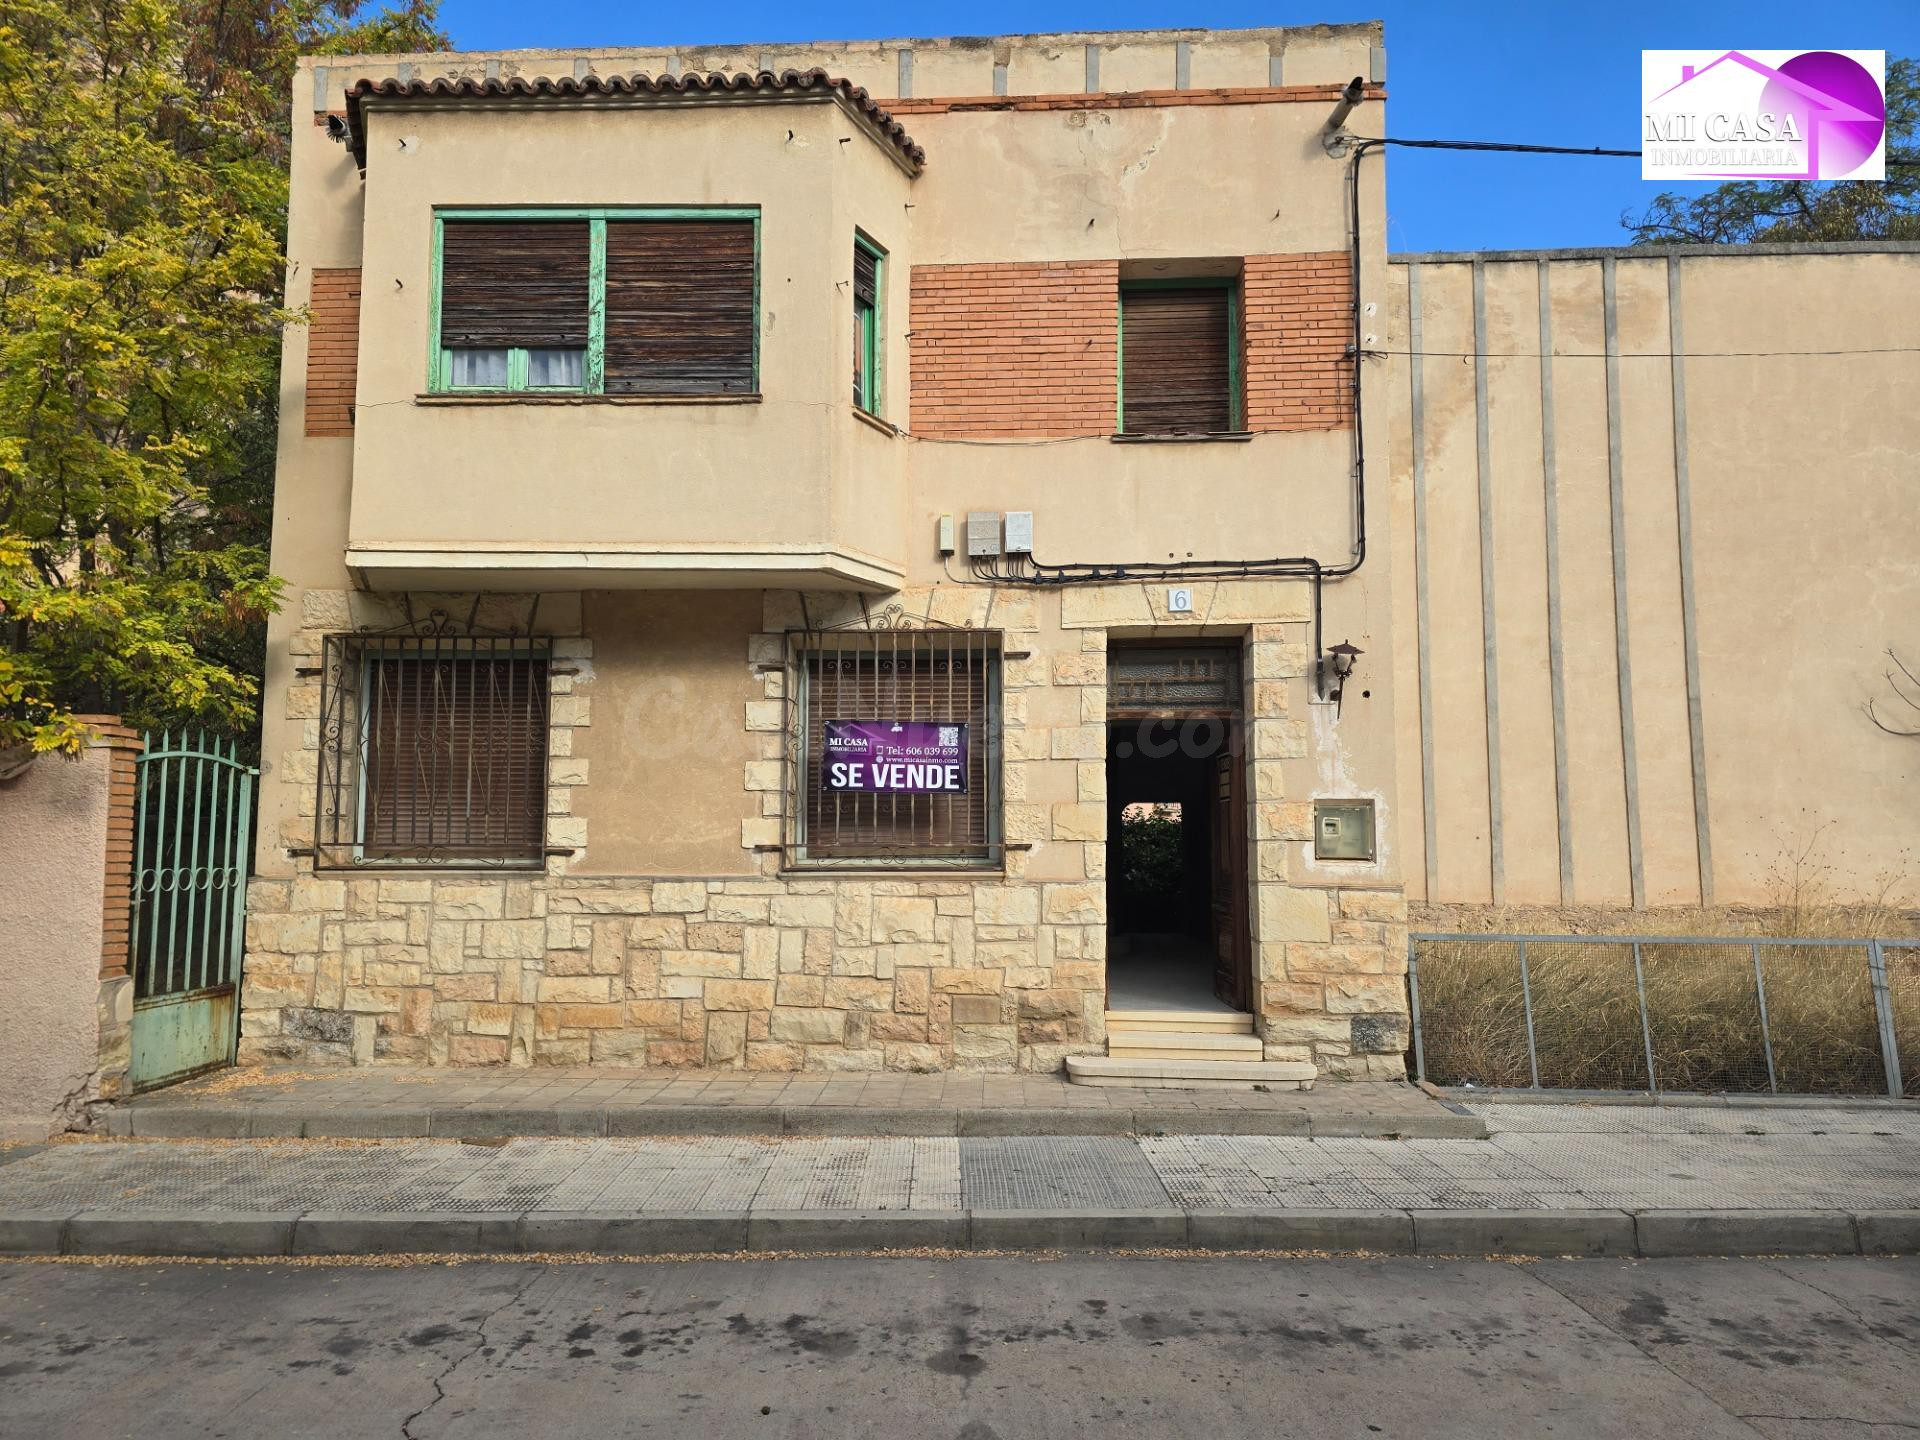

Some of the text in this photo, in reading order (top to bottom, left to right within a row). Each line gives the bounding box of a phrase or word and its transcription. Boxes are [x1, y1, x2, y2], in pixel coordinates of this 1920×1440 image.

[1174, 590, 1187, 610] 6
[829, 737, 868, 746] MI CASA
[886, 746, 959, 756] Tel: 606 039 699
[886, 756, 958, 764] www.micasainmo.com
[831, 762, 960, 789] SE VENDE
